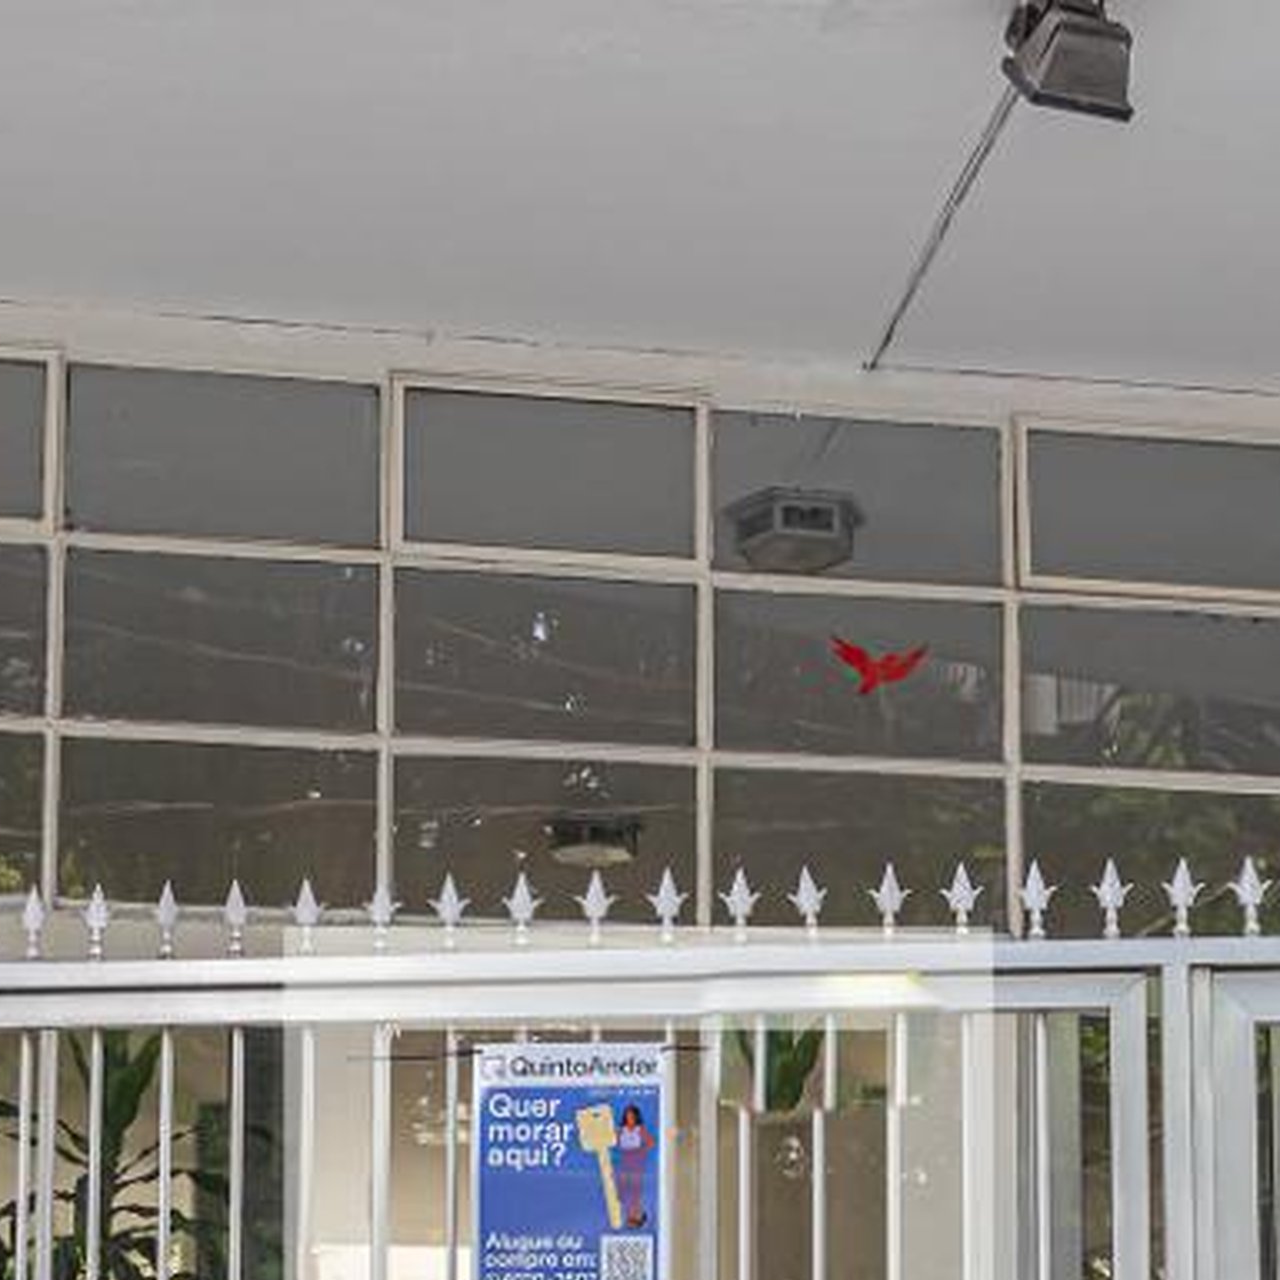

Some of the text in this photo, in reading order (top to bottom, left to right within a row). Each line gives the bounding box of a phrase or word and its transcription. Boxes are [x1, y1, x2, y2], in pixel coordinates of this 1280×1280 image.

[510, 1055, 658, 1077] QuintoAndar
[489, 1093, 561, 1119] Quer
[488, 1122, 574, 1142] morar
[488, 1143, 566, 1170] aqui?
[486, 1232, 553, 1252] Alugue
